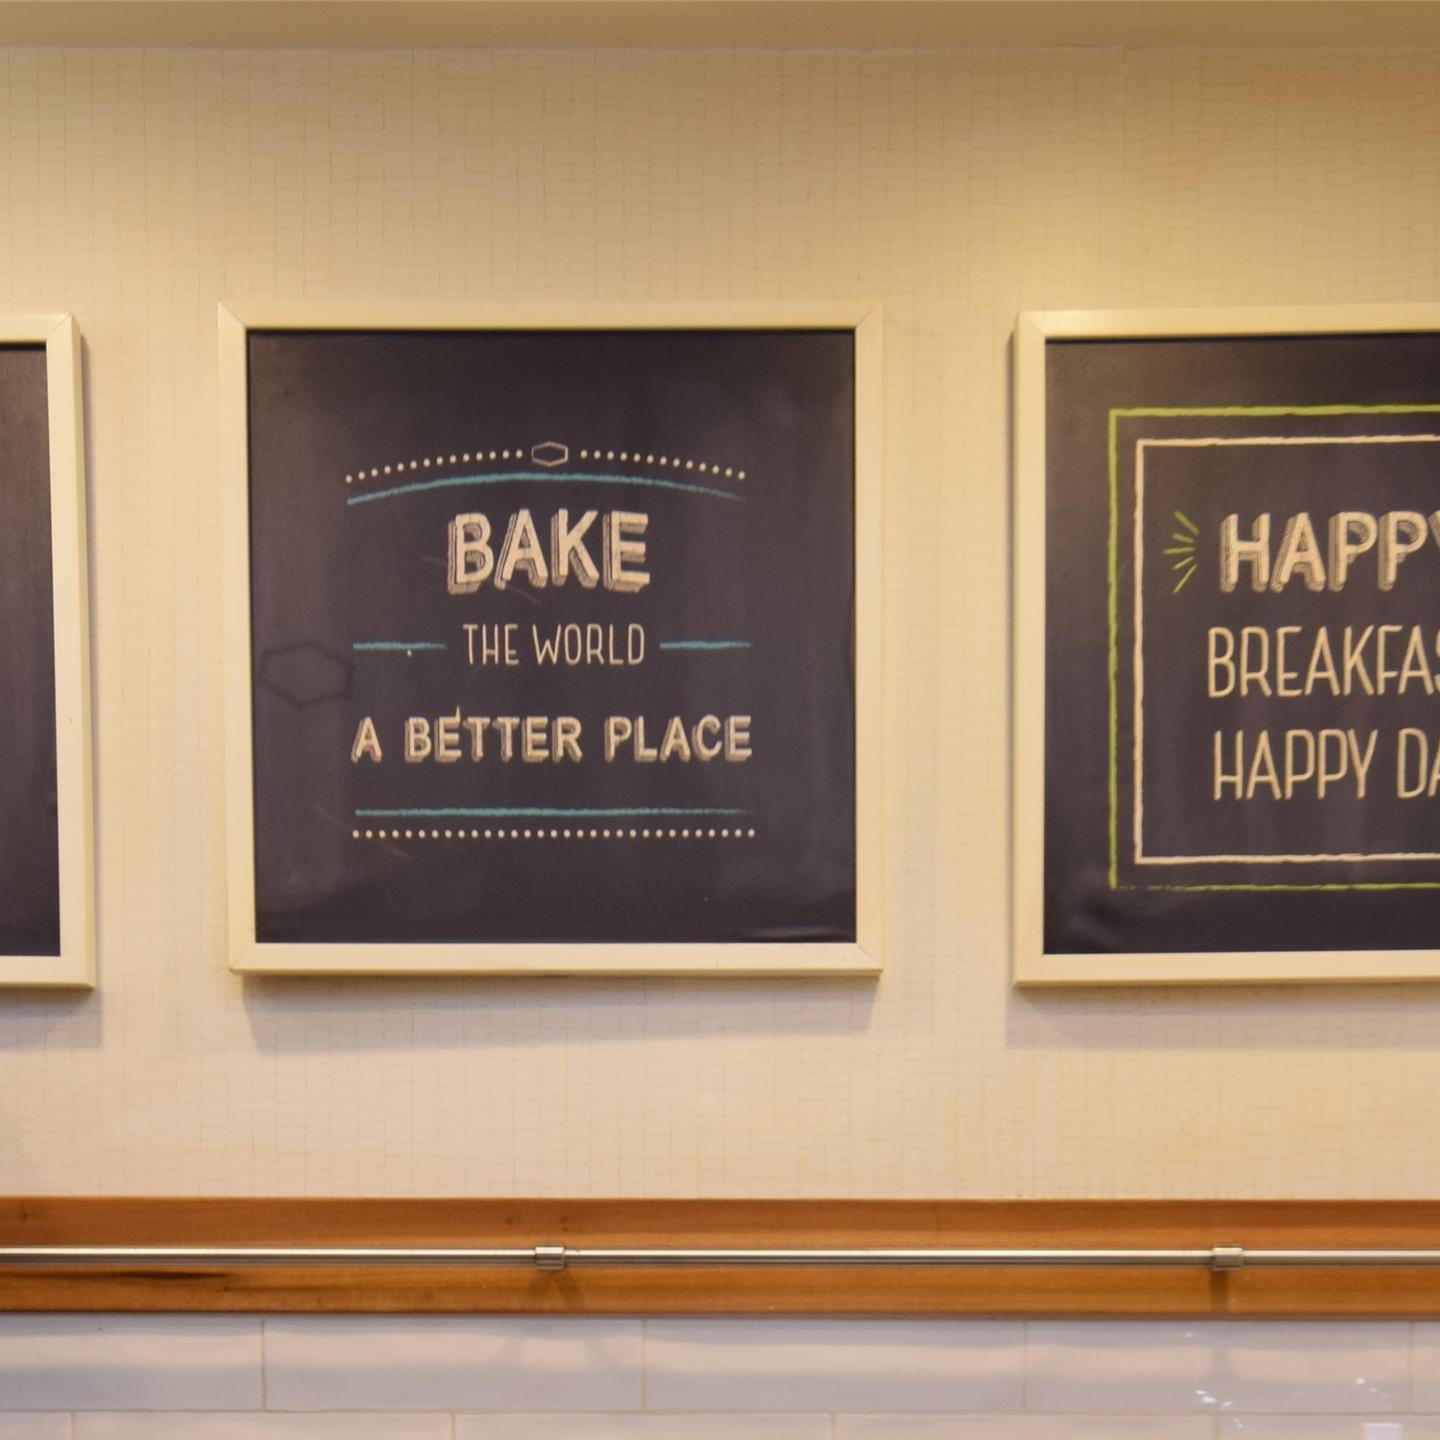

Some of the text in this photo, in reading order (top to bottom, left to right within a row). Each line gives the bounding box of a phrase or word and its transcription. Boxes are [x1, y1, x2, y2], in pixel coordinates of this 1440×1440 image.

[447, 508, 651, 595] BAKE
[463, 623, 646, 666] THE WORLD
[351, 715, 753, 763] A BETTER PLACE
[1212, 727, 1378, 801] HAPPY
